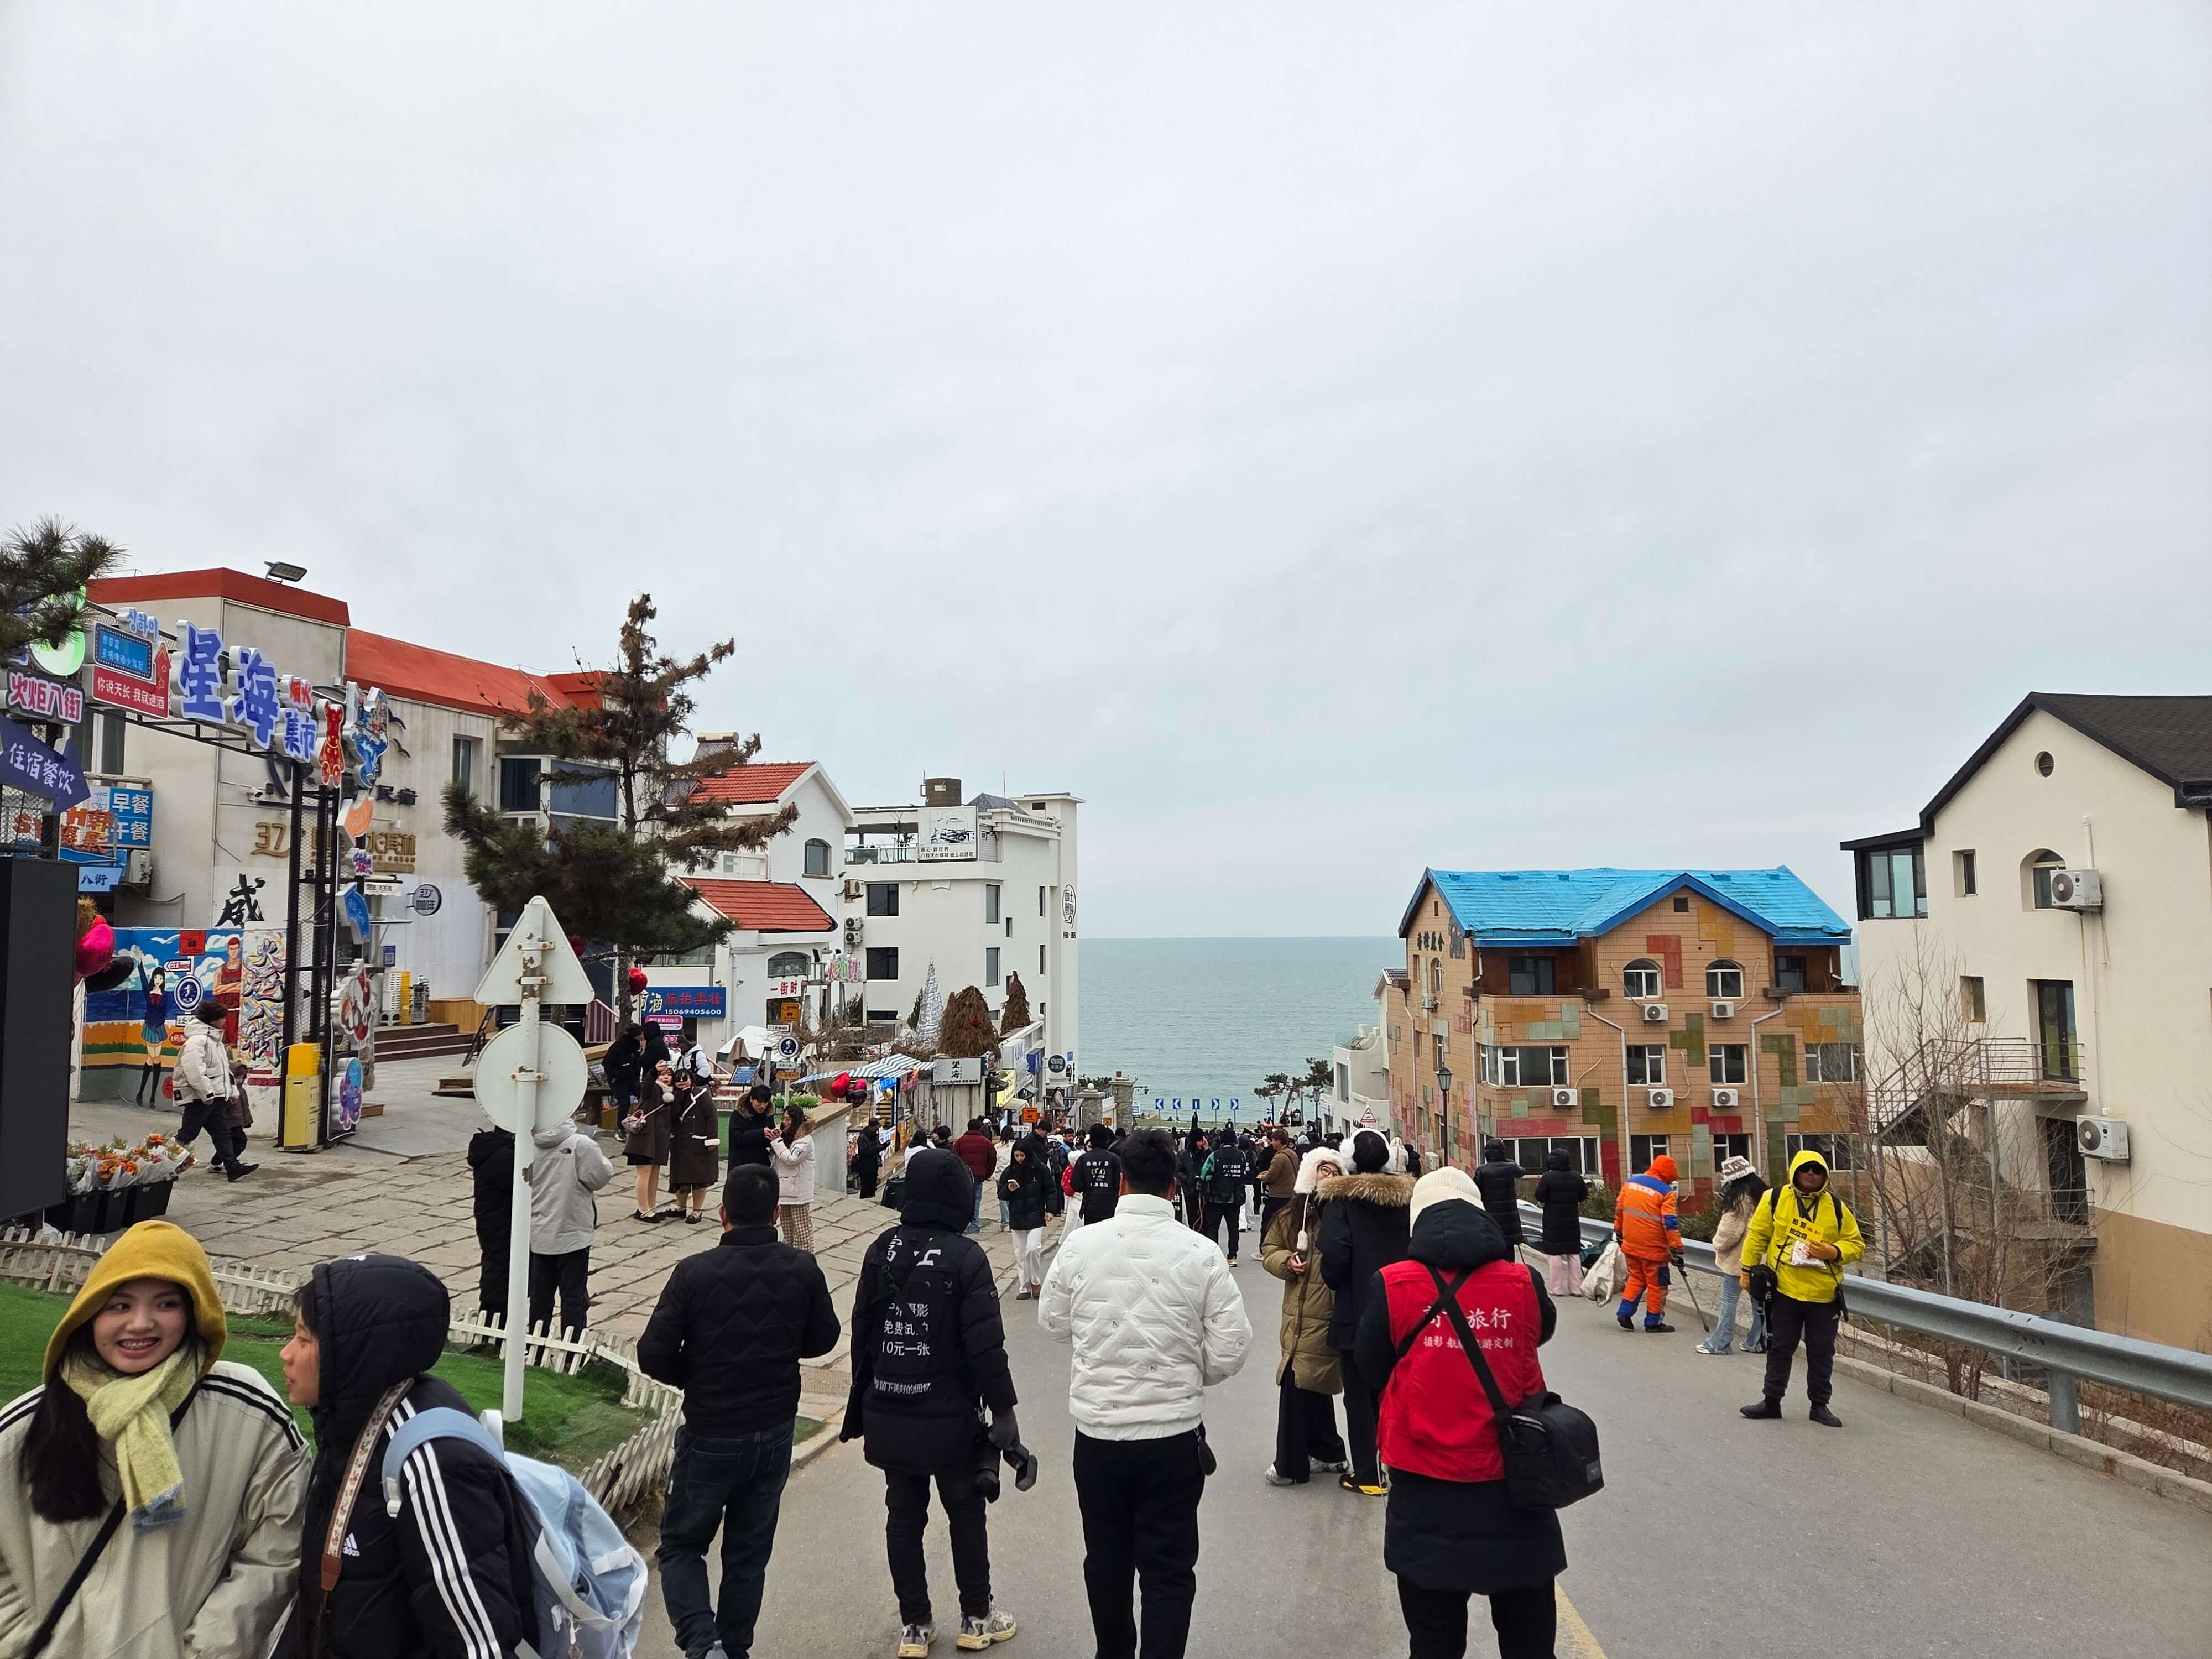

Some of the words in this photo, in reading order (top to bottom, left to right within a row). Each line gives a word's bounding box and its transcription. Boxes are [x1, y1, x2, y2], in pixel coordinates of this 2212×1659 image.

[127, 608, 159, 640] 싱하이
[10, 674, 81, 721] 火炬八街
[97, 676, 131, 700] 你说天长
[179, 622, 279, 749] 星海
[284, 709, 317, 762] 集市
[9, 742, 76, 795] 住宿餐饮
[112, 792, 150, 815] 早餐
[111, 820, 149, 842] 午餐
[255, 822, 287, 851] 37
[664, 991, 723, 1005] 旅拍美妆
[881, 1340, 931, 1357] 10元一张
